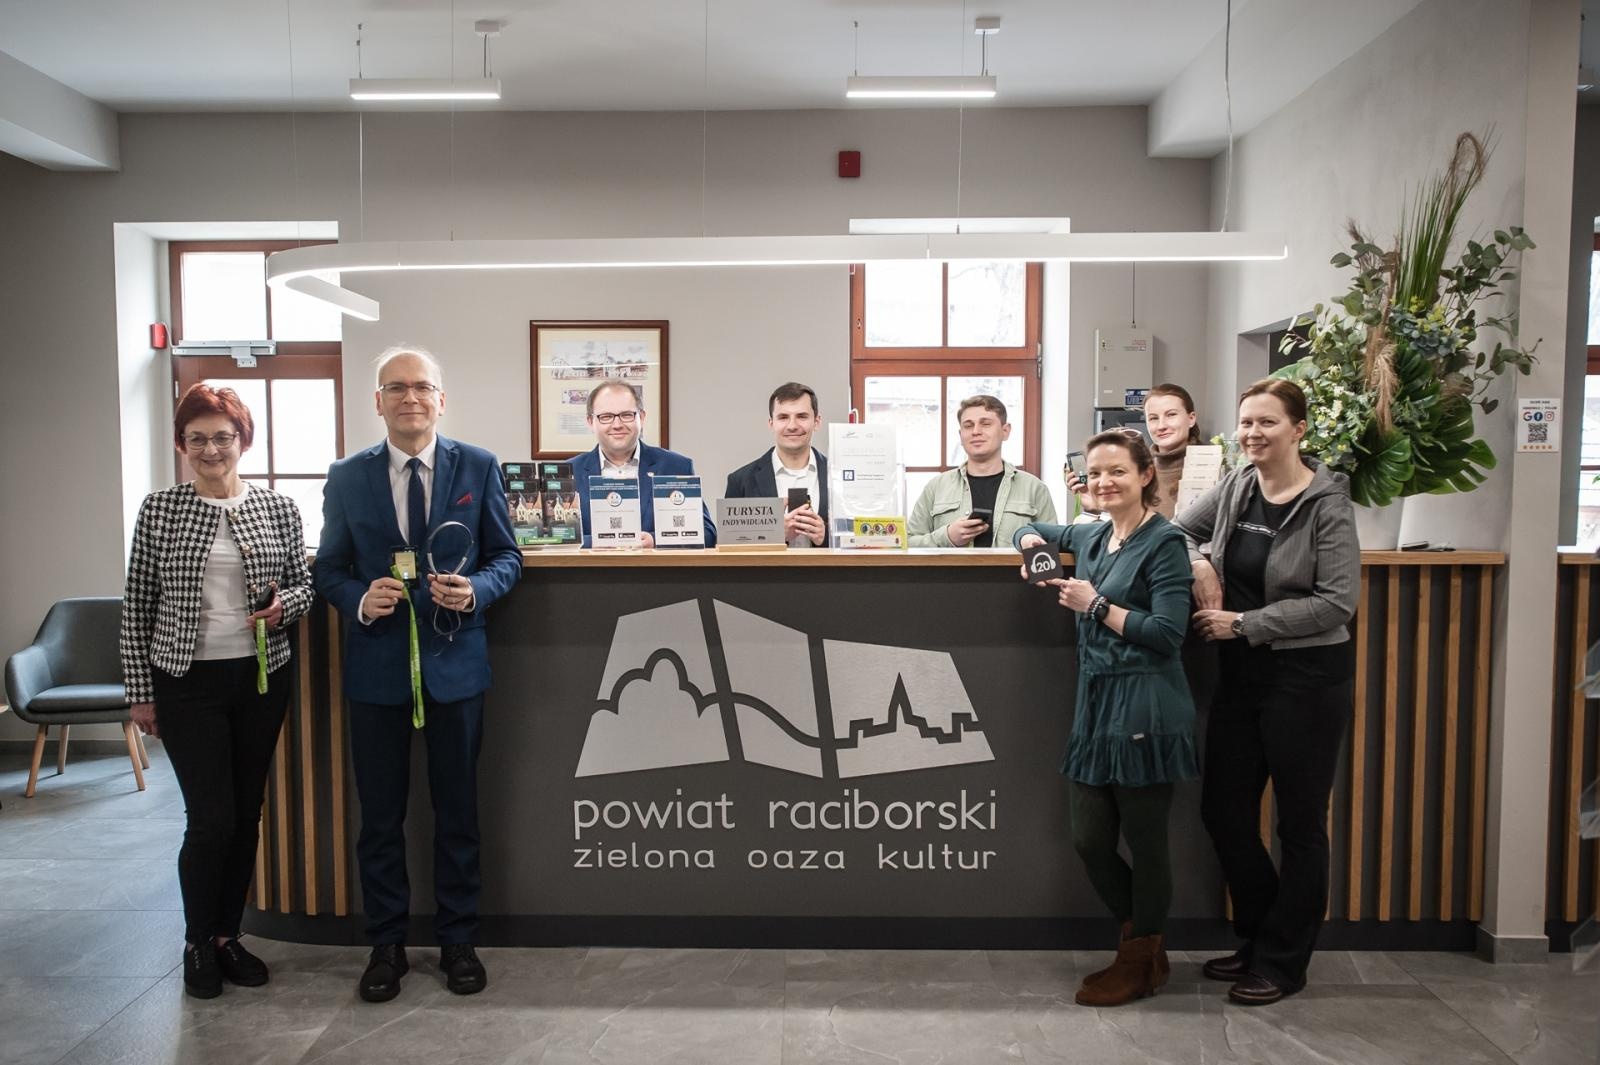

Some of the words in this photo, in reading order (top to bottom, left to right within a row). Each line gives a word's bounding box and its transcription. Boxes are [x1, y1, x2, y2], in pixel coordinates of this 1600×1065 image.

[726, 506, 774, 516] TURYSTA
[722, 518, 778, 526] INDYWIDUALNY
[1036, 560, 1050, 572] 20
[573, 788, 736, 840] powiat
[769, 788, 997, 830] raciborski
[573, 841, 715, 869] zielona
[747, 850, 846, 870] oaza
[878, 842, 997, 870] kultur
